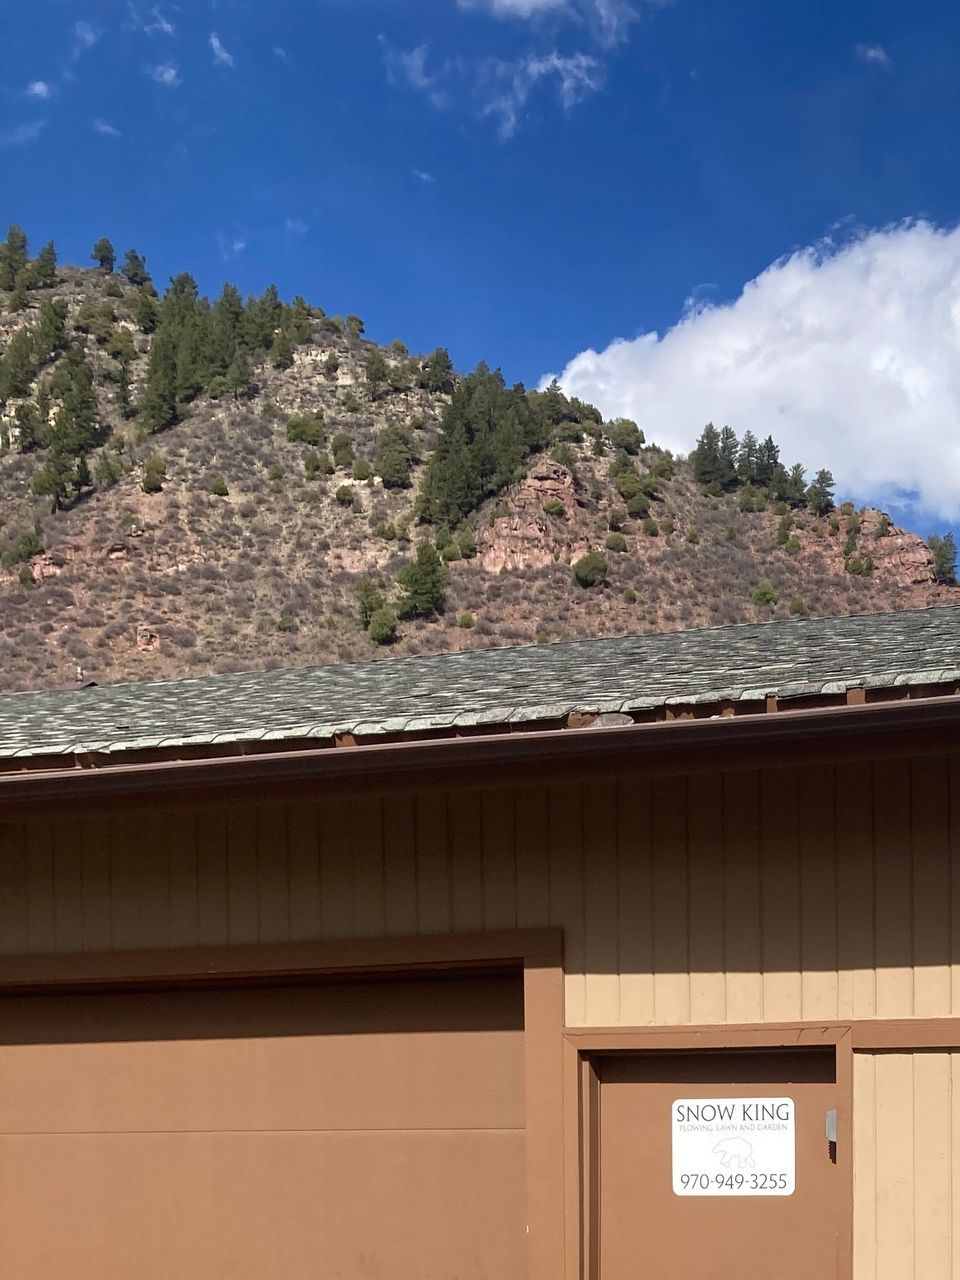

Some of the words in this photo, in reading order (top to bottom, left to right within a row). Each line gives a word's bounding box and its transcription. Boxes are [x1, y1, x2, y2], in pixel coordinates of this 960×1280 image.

[677, 1104, 735, 1122] SNOW
[742, 1103, 789, 1121] KING
[716, 1124, 737, 1132] LAWN
[757, 1123, 788, 1131] GARDEN
[680, 1174, 787, 1189] 970-949-3255
